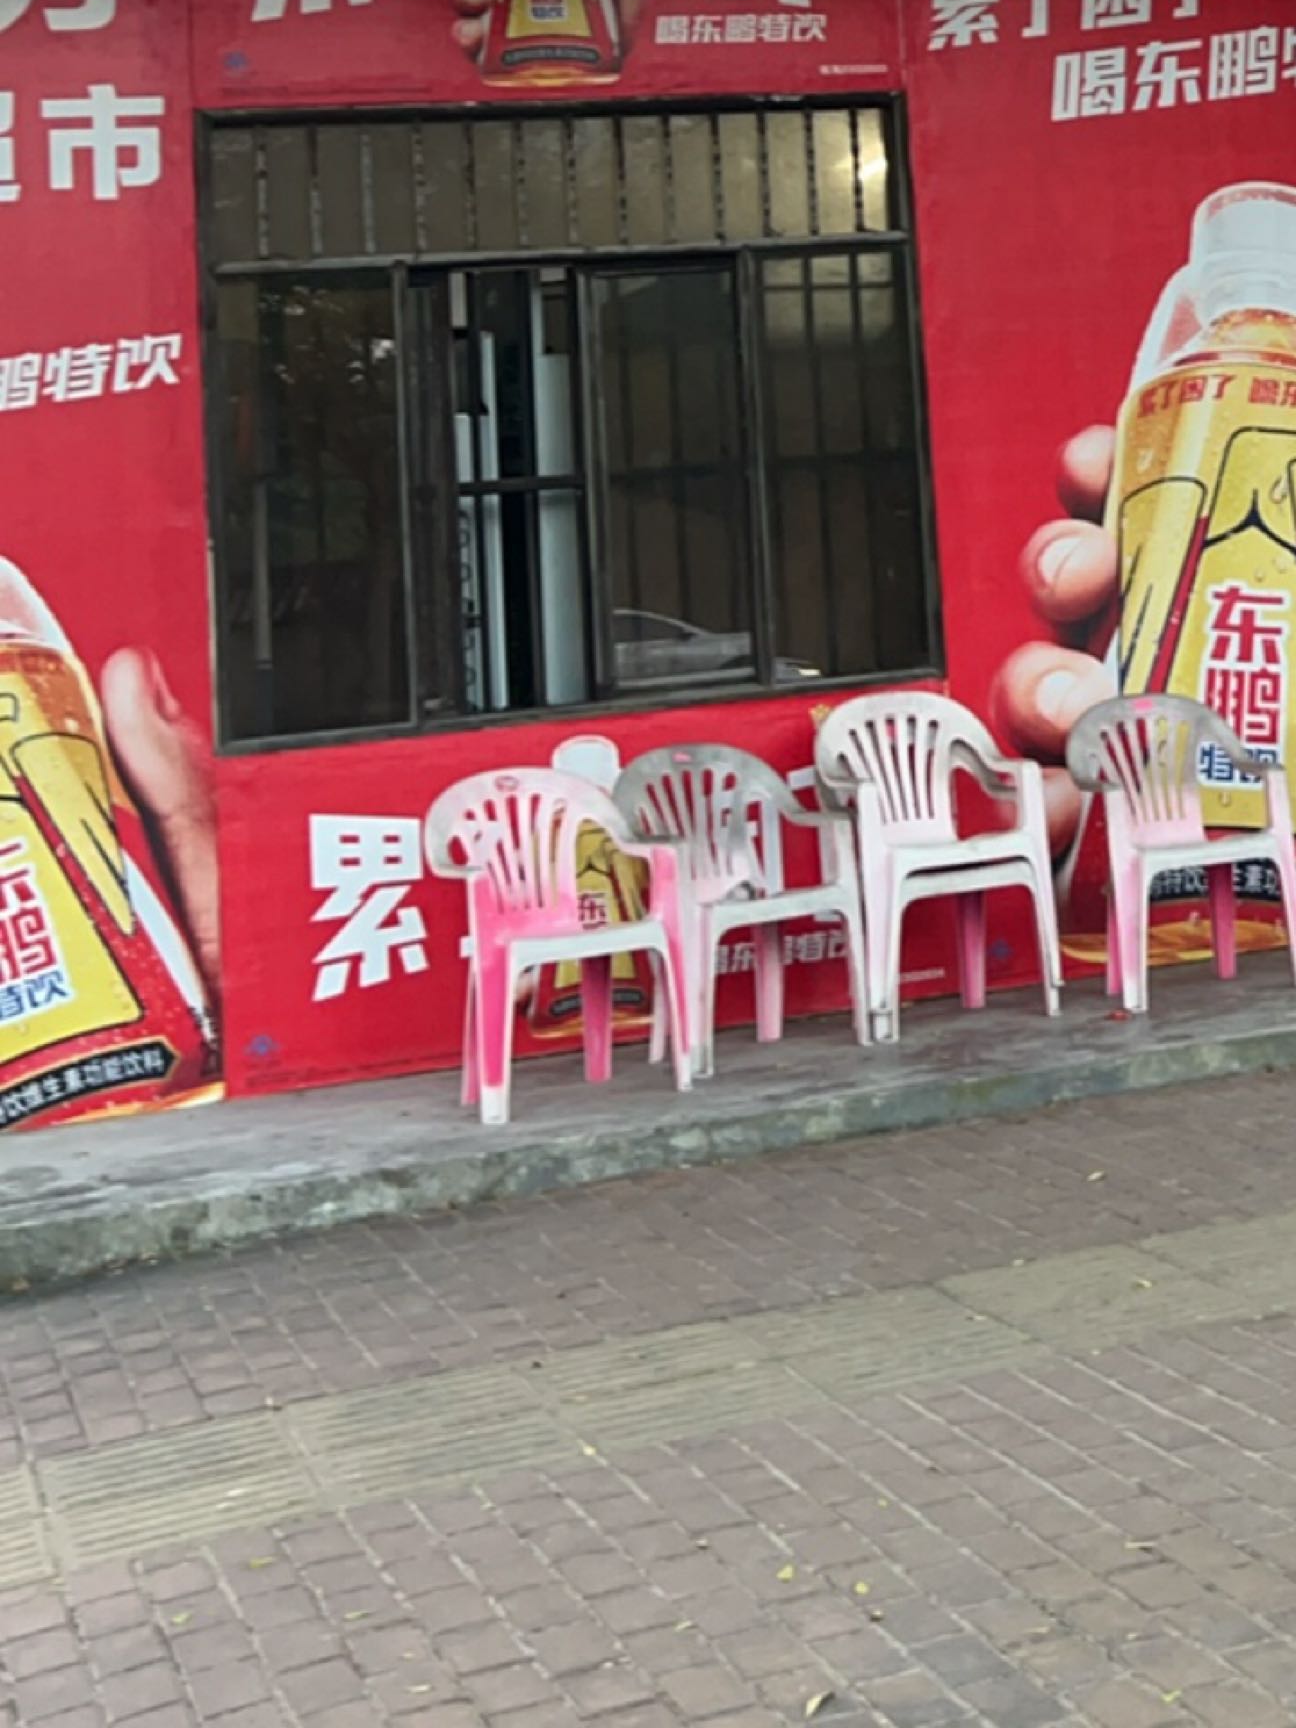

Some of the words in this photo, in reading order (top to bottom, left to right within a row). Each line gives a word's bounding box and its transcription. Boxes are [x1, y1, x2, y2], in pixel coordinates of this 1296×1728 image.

[655, 14, 827, 44] 喝东鹏特饮
[0, 84, 166, 202] 市
[1203, 585, 1285, 745] 东鹏
